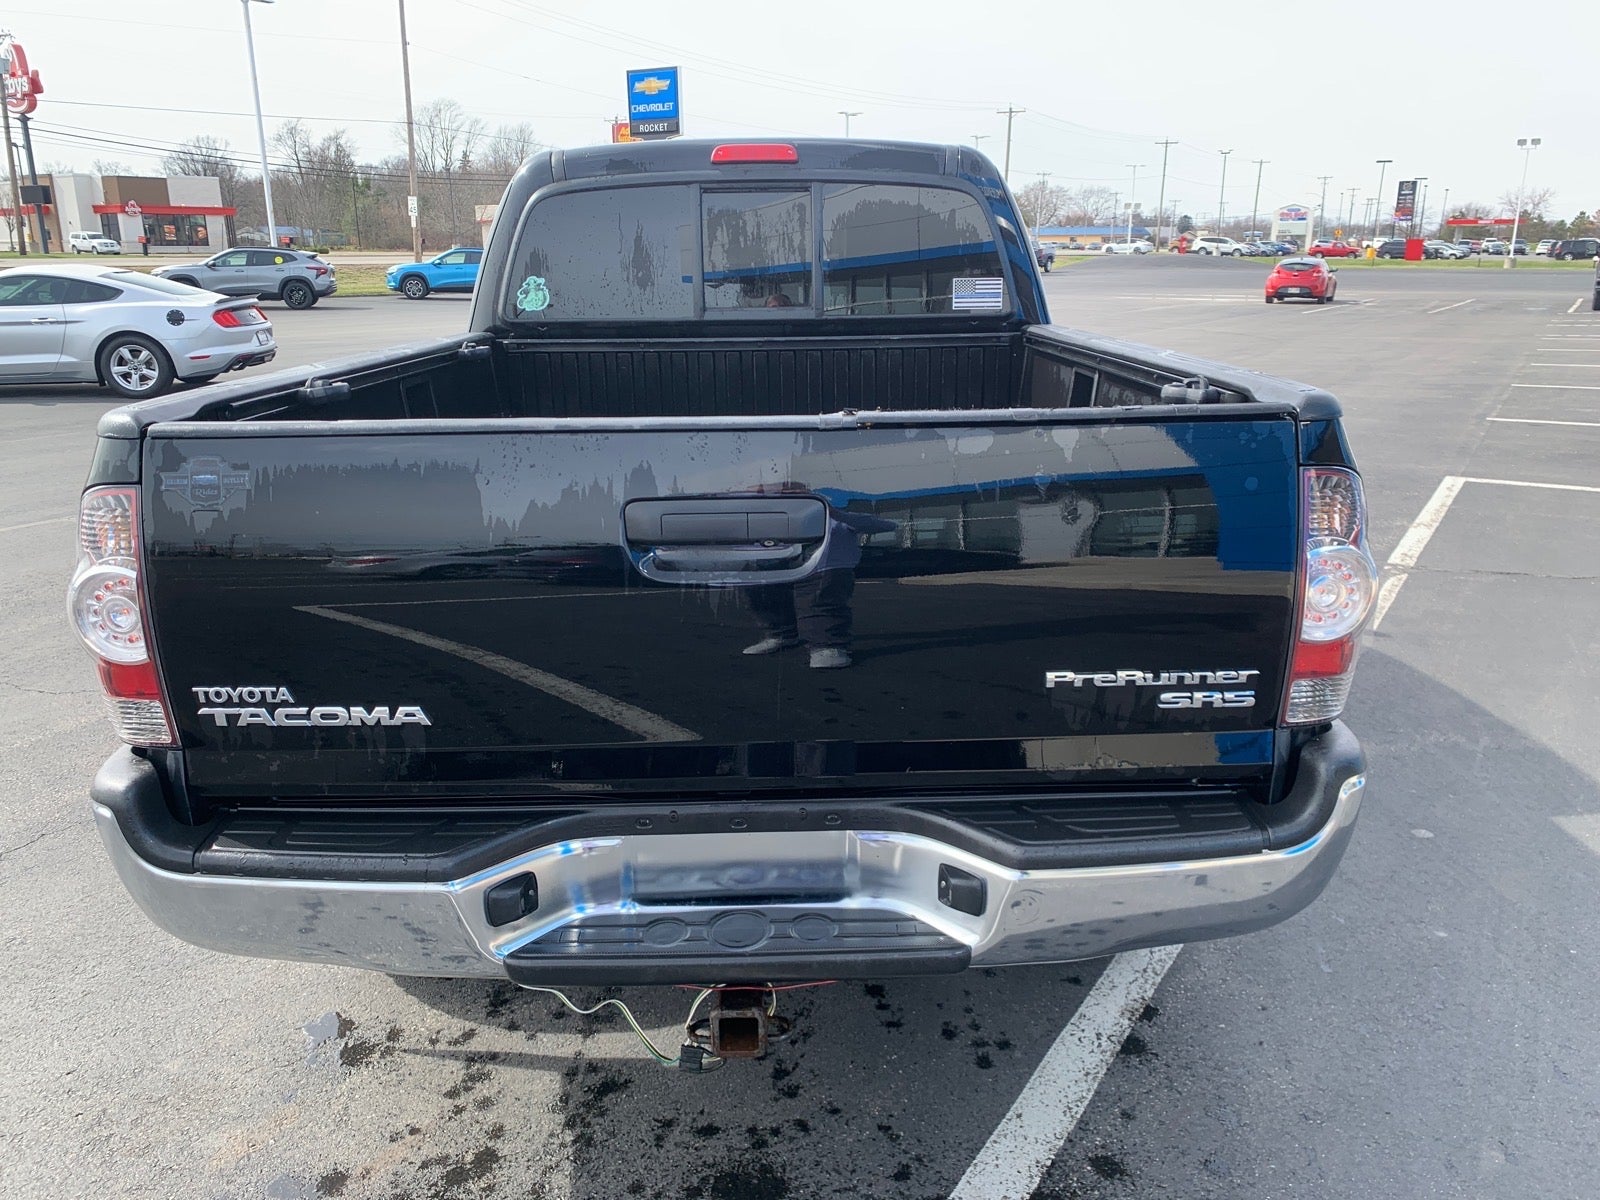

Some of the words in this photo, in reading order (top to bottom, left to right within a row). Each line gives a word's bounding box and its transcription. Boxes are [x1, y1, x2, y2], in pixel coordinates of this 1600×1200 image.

[631, 102, 674, 113] CHEVROLET
[640, 123, 668, 132] ROCKET
[1045, 670, 1260, 688] PreRunner
[192, 687, 295, 704] TOYOTA
[1157, 691, 1256, 709] SR5
[197, 706, 432, 727] TACOMA
